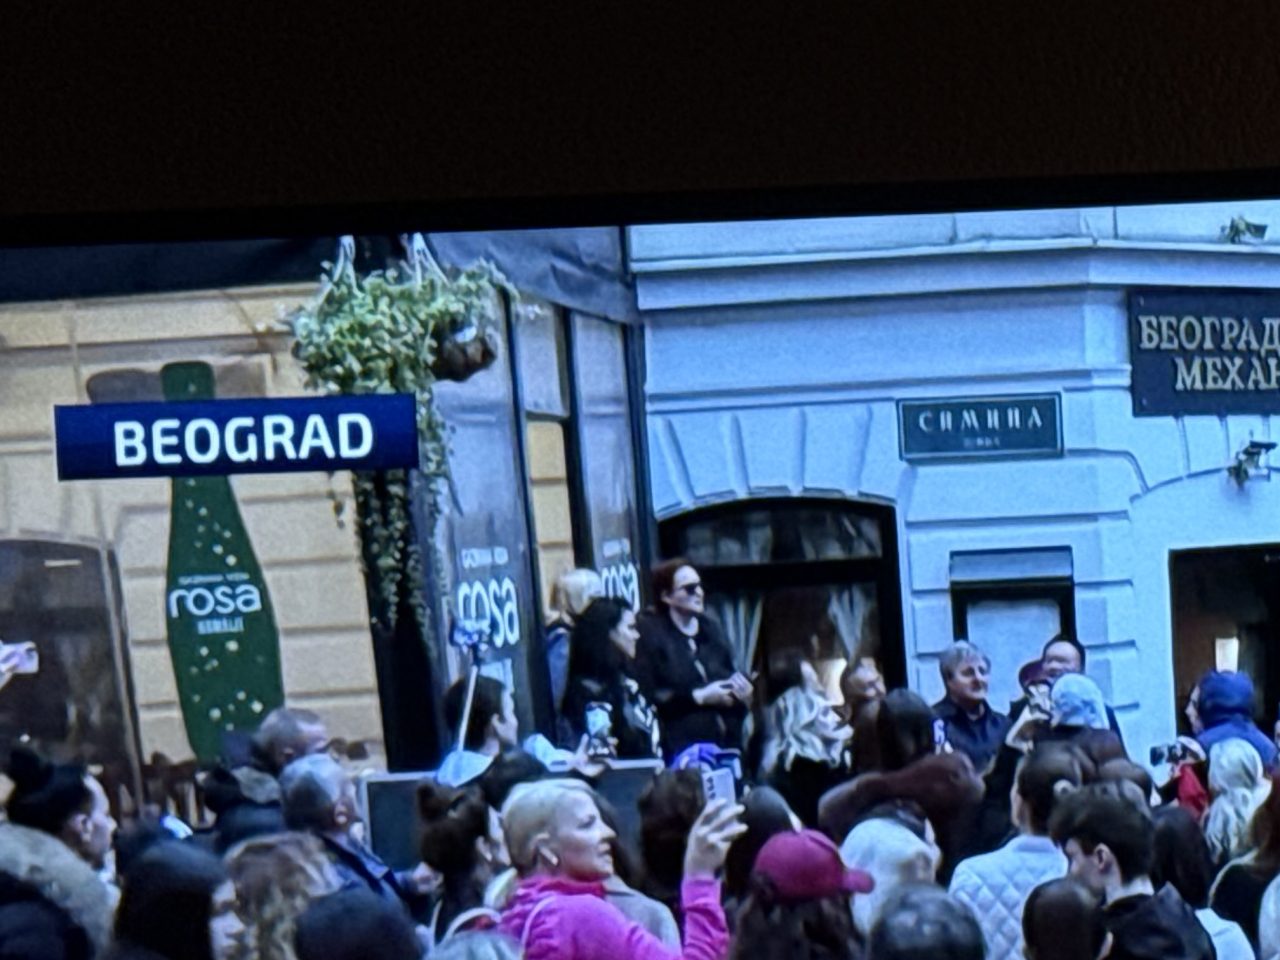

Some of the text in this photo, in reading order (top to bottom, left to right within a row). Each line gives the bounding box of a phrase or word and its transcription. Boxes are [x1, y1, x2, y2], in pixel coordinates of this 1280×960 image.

[114, 412, 374, 467] BEOGRAD
[169, 584, 262, 618] rosa
[458, 576, 520, 648] rosa
